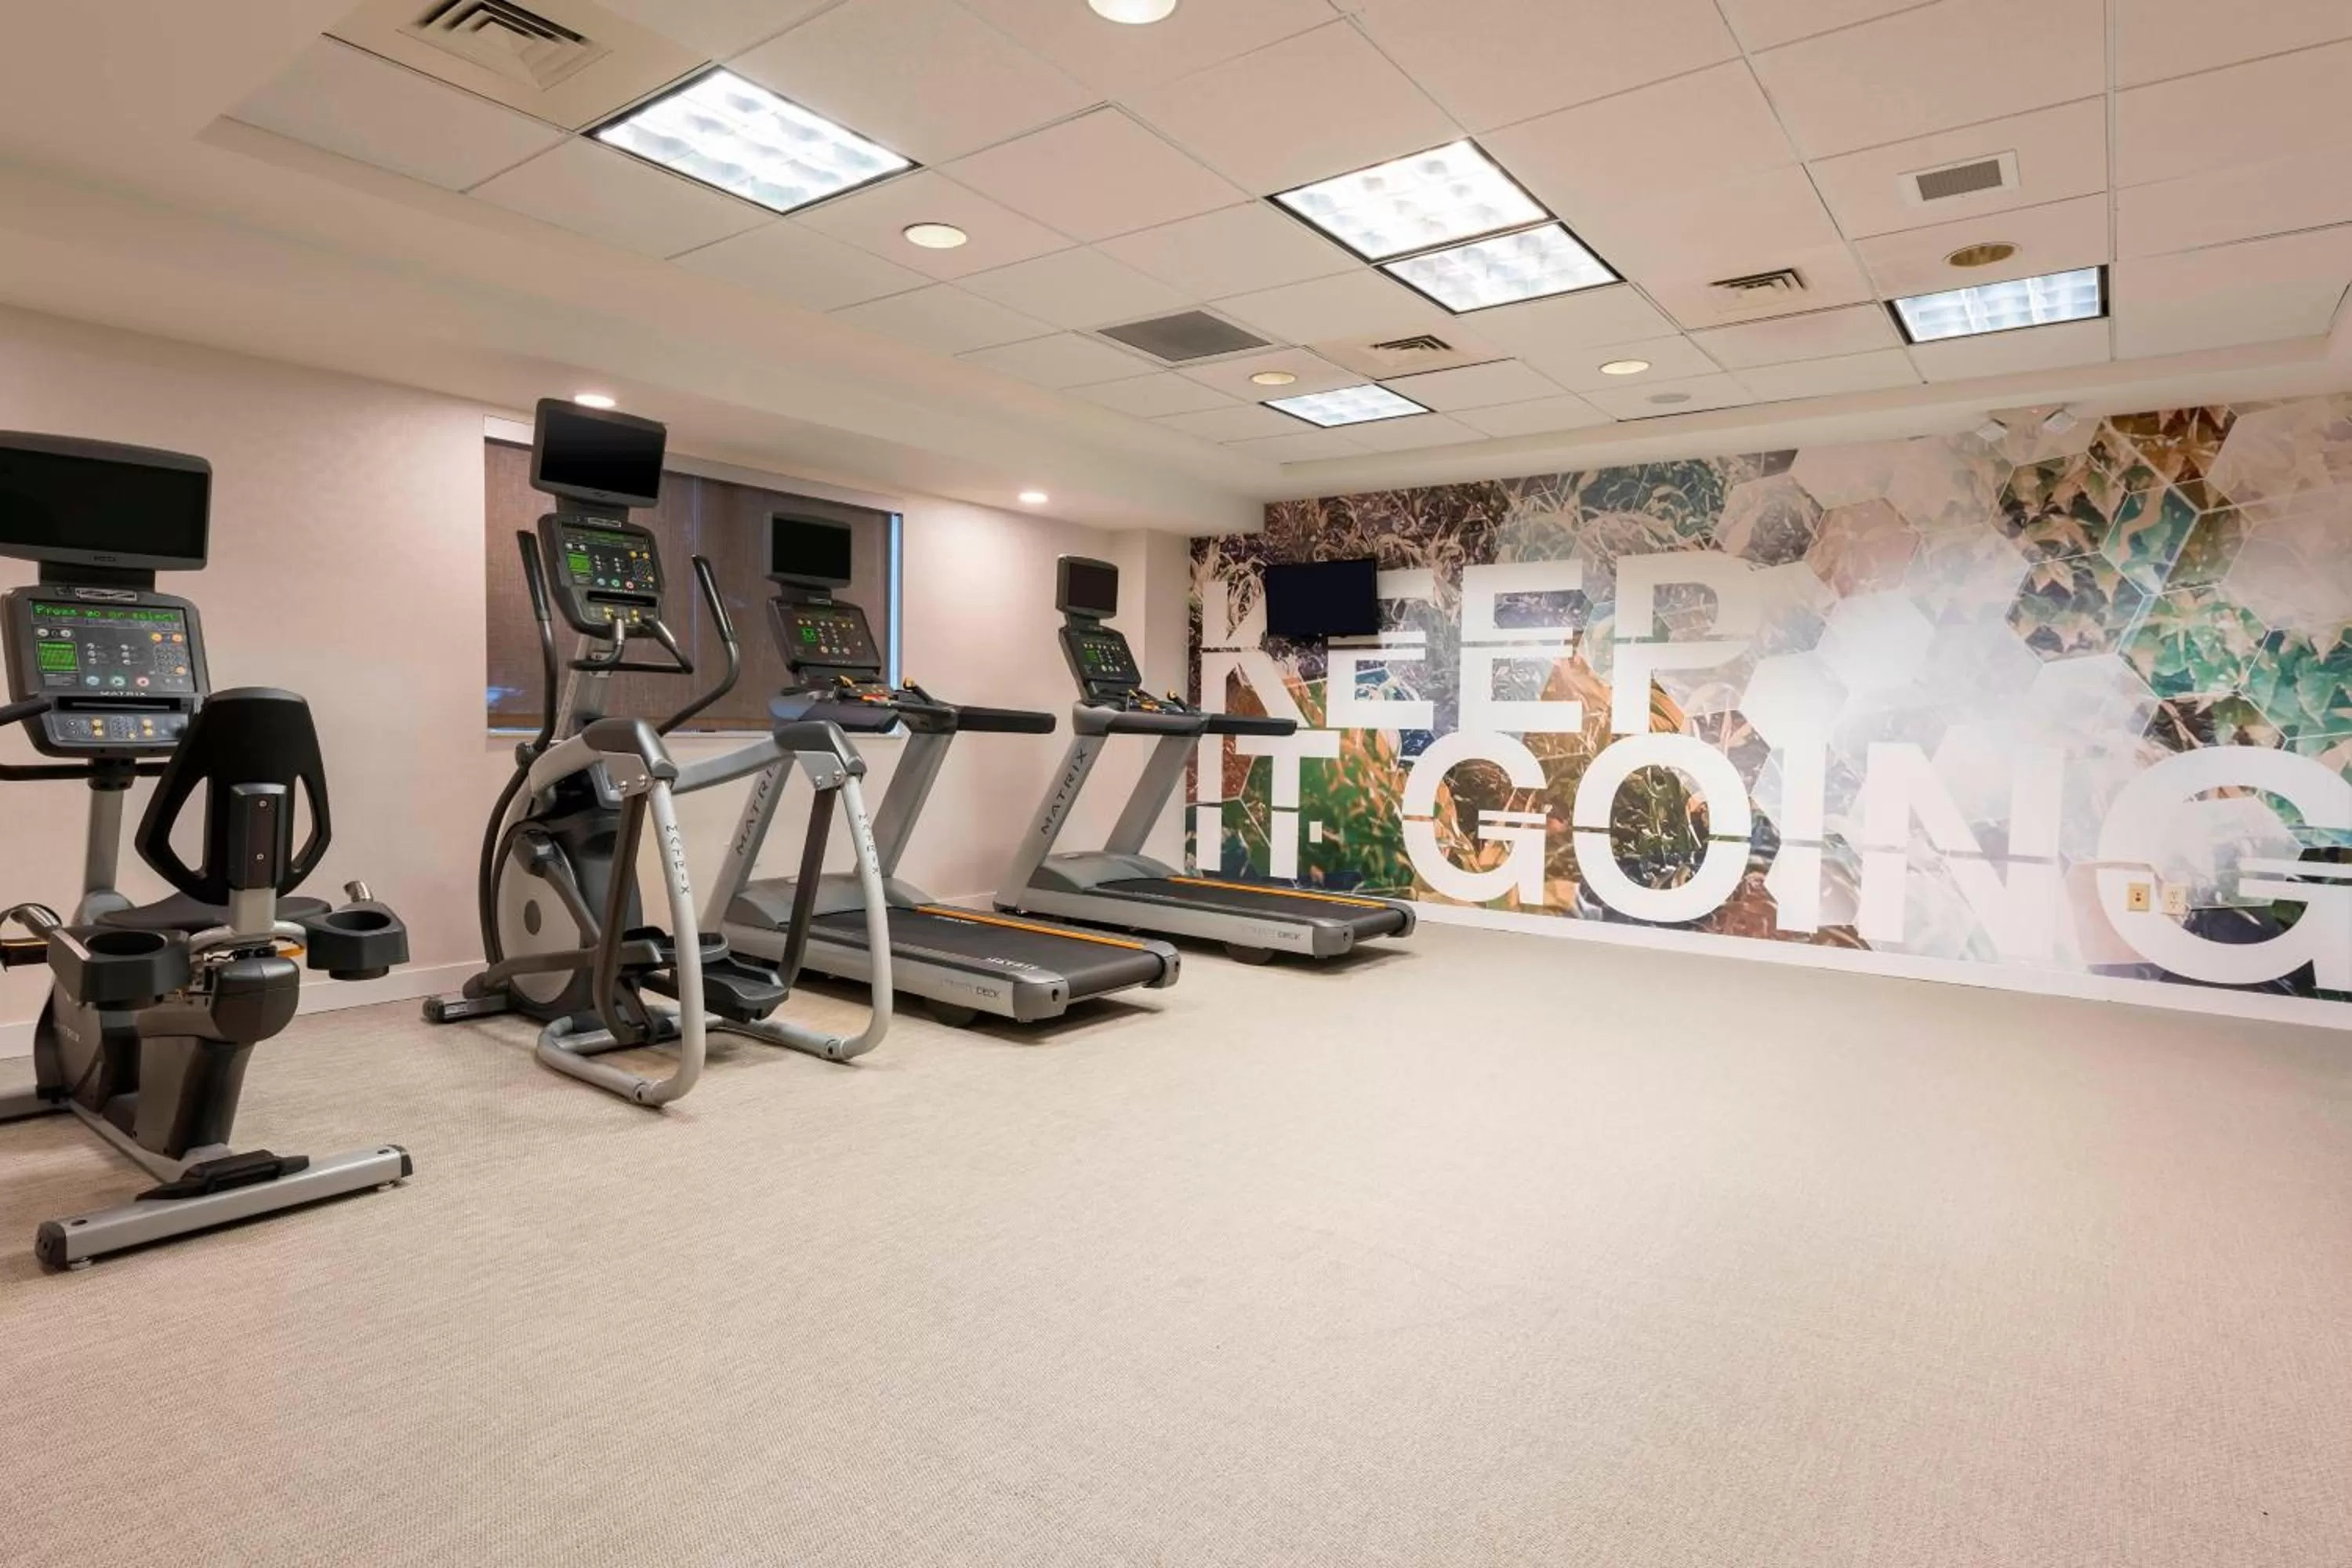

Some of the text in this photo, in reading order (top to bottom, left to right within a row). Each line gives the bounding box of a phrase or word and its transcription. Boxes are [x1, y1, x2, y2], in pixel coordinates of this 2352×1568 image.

[1200, 550, 1762, 735] KEEP
[858, 812, 879, 875] MATRIX
[1040, 747, 1088, 836] MATRIX
[1195, 729, 1341, 880] IT.
[666, 825, 691, 895] MATRIX
[1401, 731, 2352, 993] GOING
